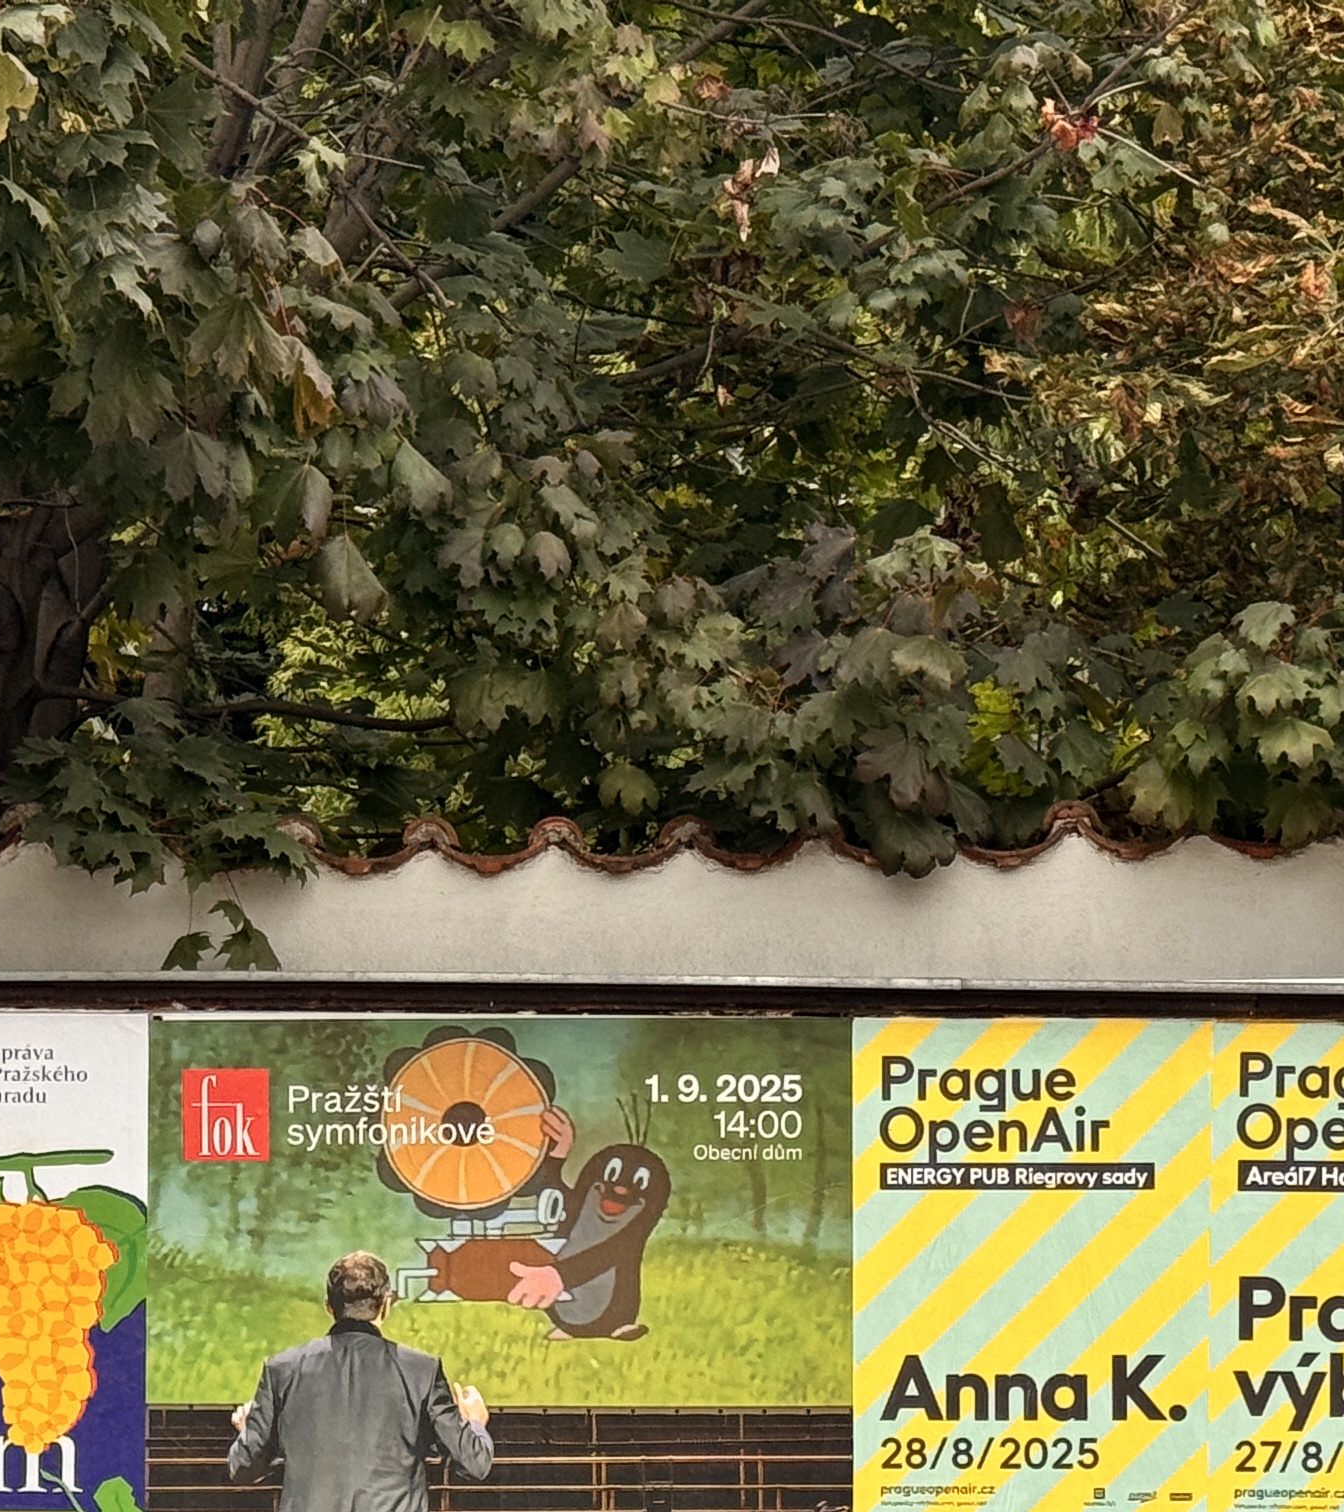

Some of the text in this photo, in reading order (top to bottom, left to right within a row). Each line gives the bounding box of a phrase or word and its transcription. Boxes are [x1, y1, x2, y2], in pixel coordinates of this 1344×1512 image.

[288, 1083, 403, 1114] Pražští
[645, 1074, 803, 1103] 1. 9. 2025
[881, 1056, 1076, 1112] Prague
[190, 1074, 262, 1159] fok
[287, 1114, 495, 1149] symfonikové
[714, 1110, 803, 1138] 14:00
[879, 1106, 1110, 1163] OpenAir
[693, 1144, 803, 1162] Obecní dům
[886, 1167, 1148, 1189] ENERGY PUB Riegrovy sady
[1246, 1166, 1317, 1186] Areál7
[879, 1354, 1187, 1422] Anna K.
[880, 1437, 1099, 1470] 28/8/2025
